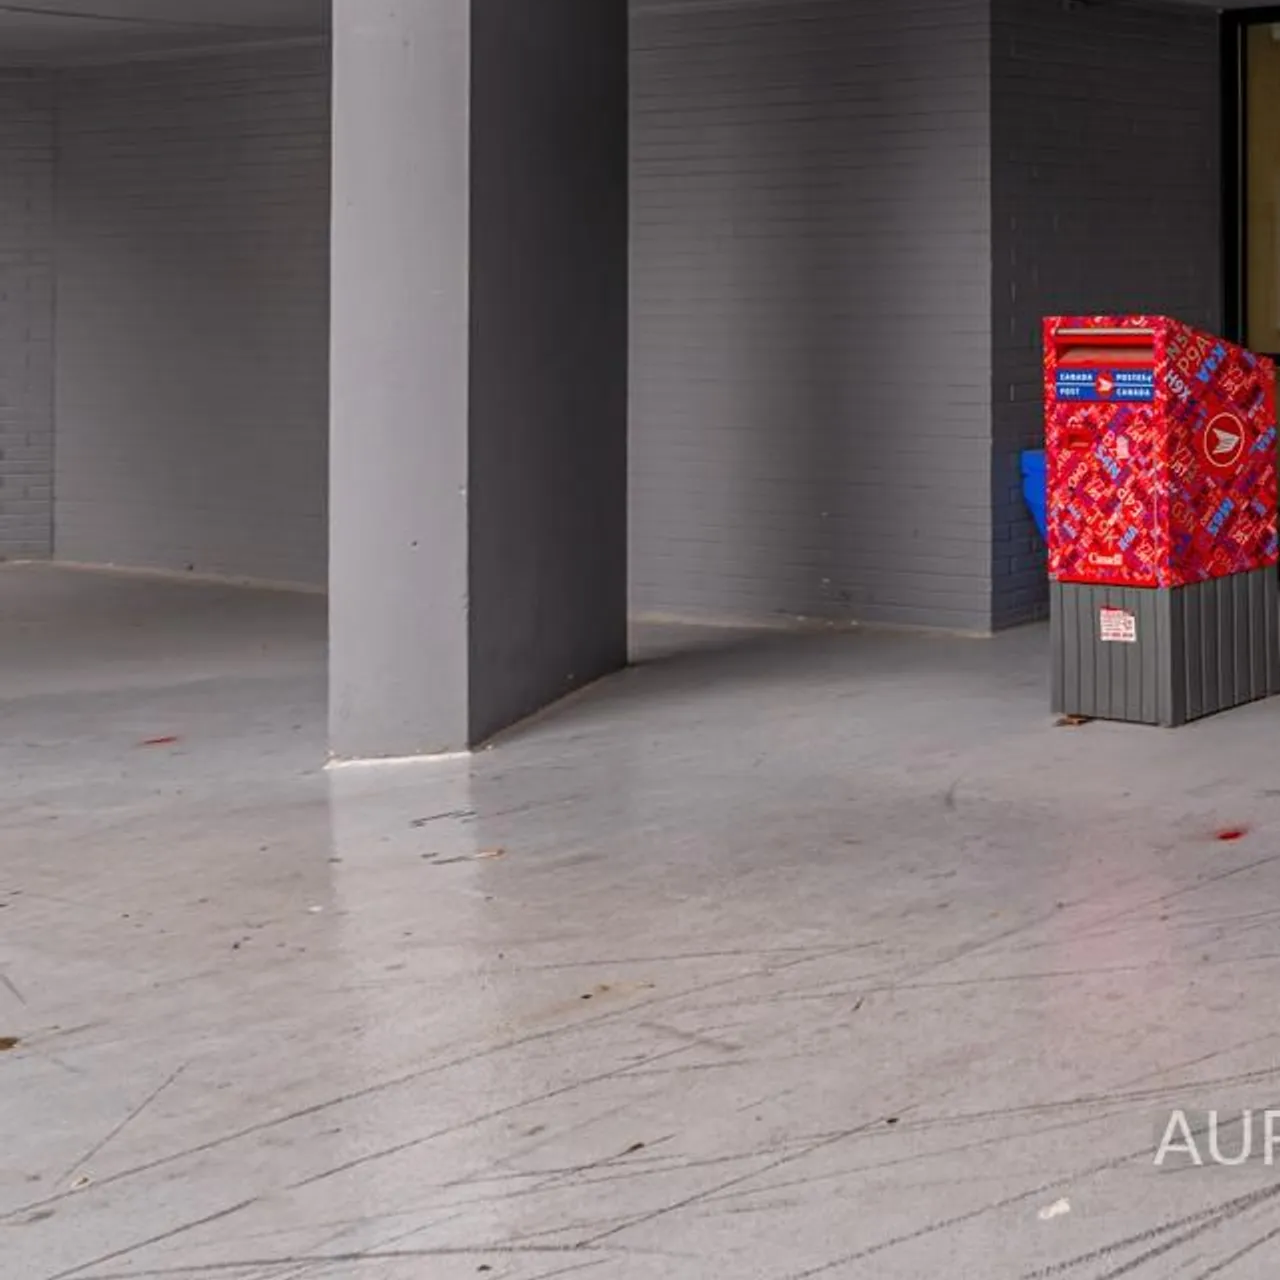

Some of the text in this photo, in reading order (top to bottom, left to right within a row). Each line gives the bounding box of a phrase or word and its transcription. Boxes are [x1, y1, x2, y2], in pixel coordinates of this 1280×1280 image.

[1059, 373, 1093, 381] CANADA
[1059, 386, 1080, 396] POST
[1115, 387, 1151, 397] CANADA
